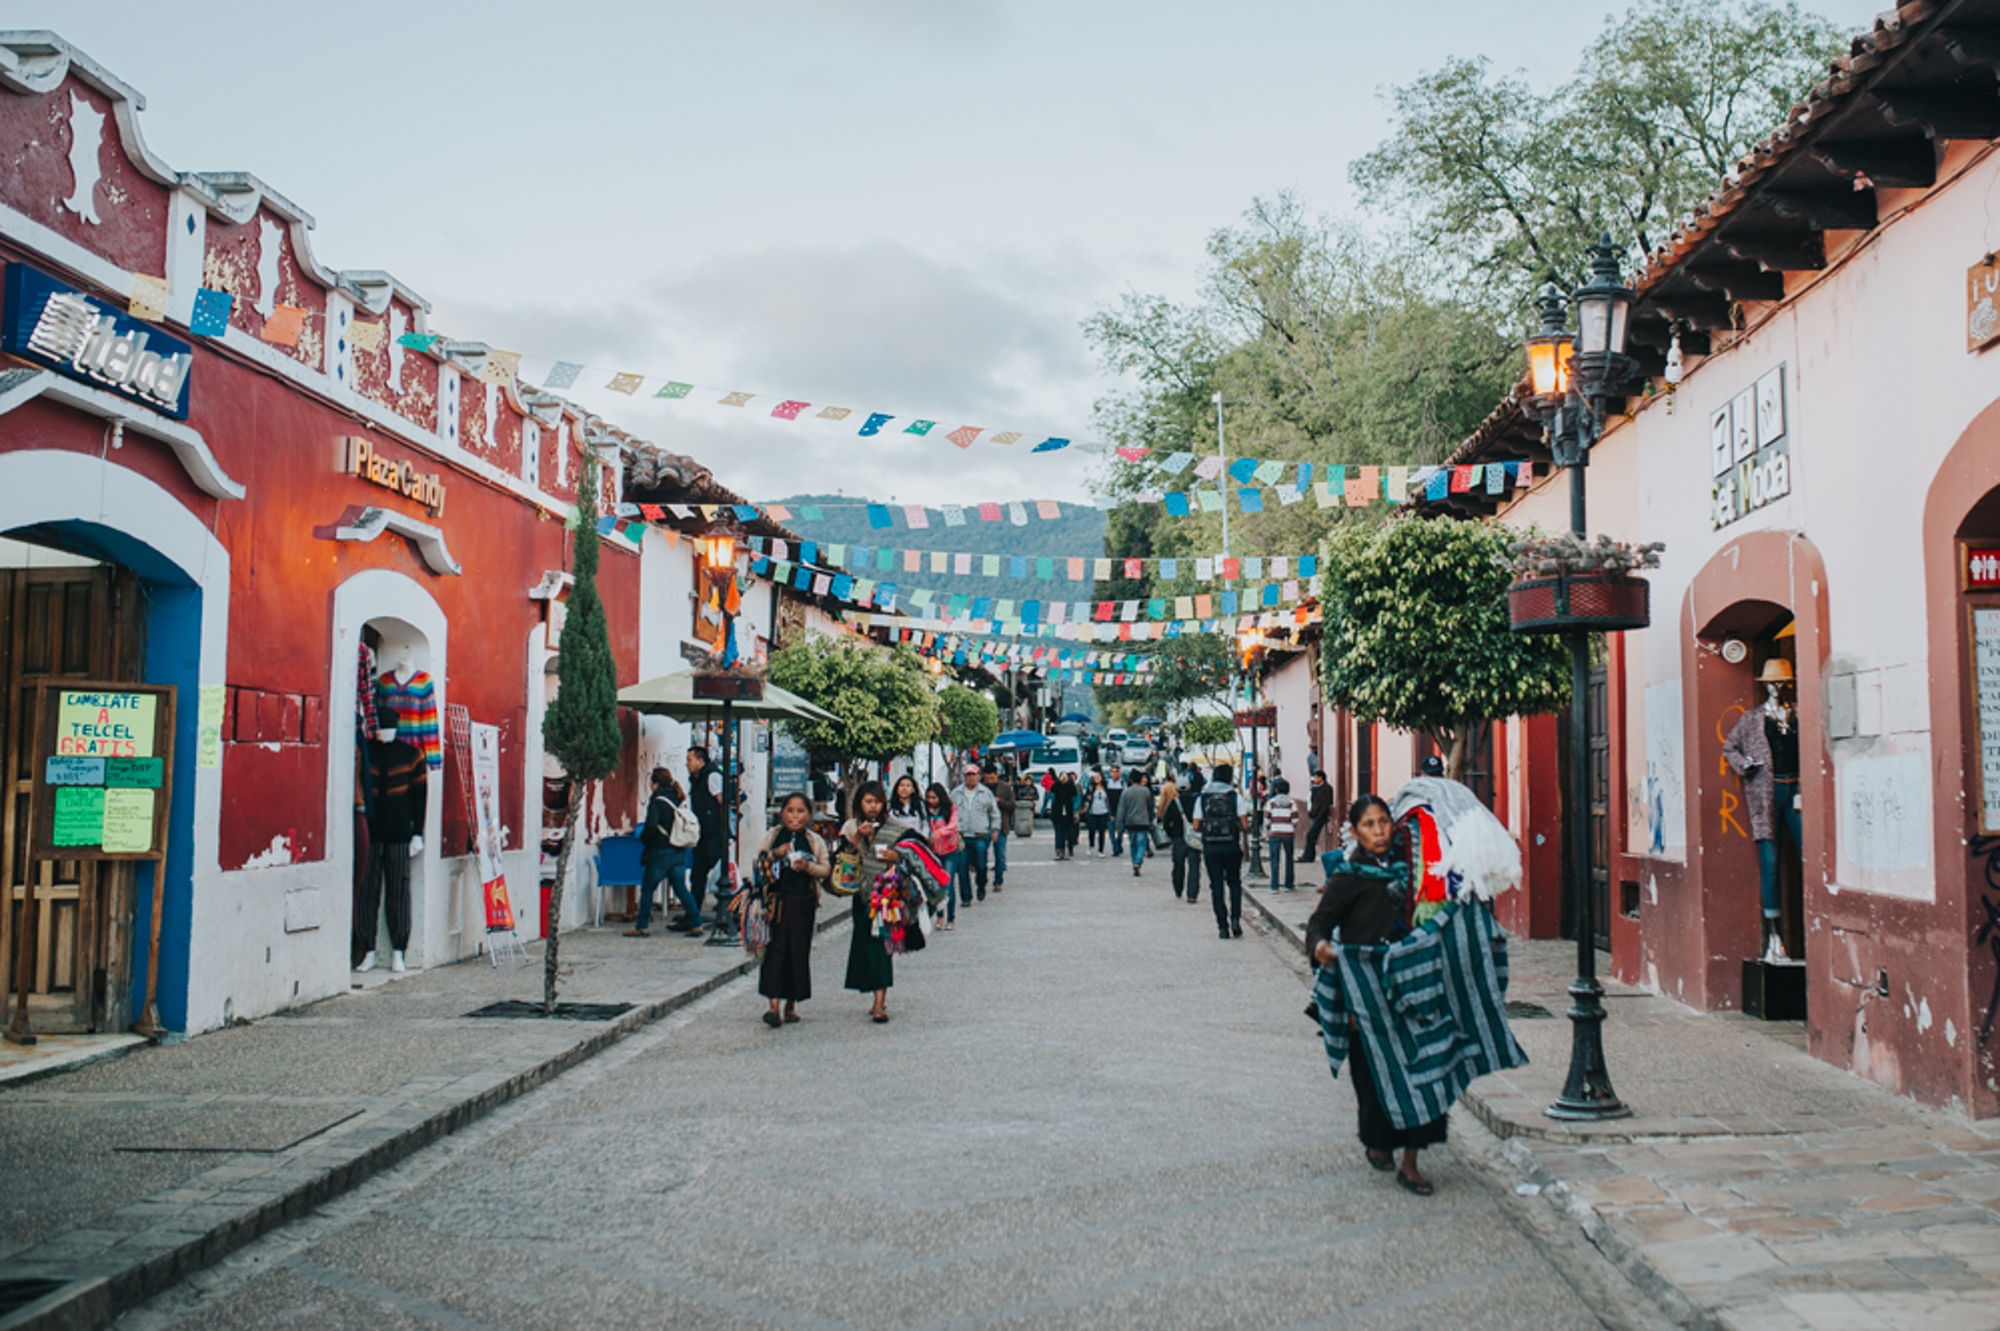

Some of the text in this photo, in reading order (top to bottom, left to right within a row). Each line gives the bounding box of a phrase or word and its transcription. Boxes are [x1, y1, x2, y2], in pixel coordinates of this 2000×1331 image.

[354, 435, 446, 518] Plaza Candy
[1739, 450, 1791, 515] Moda
[66, 694, 141, 709] CAMBIATE
[97, 707, 110, 725] A
[71, 722, 134, 740] TELCEL
[61, 736, 137, 758] GRATIS
